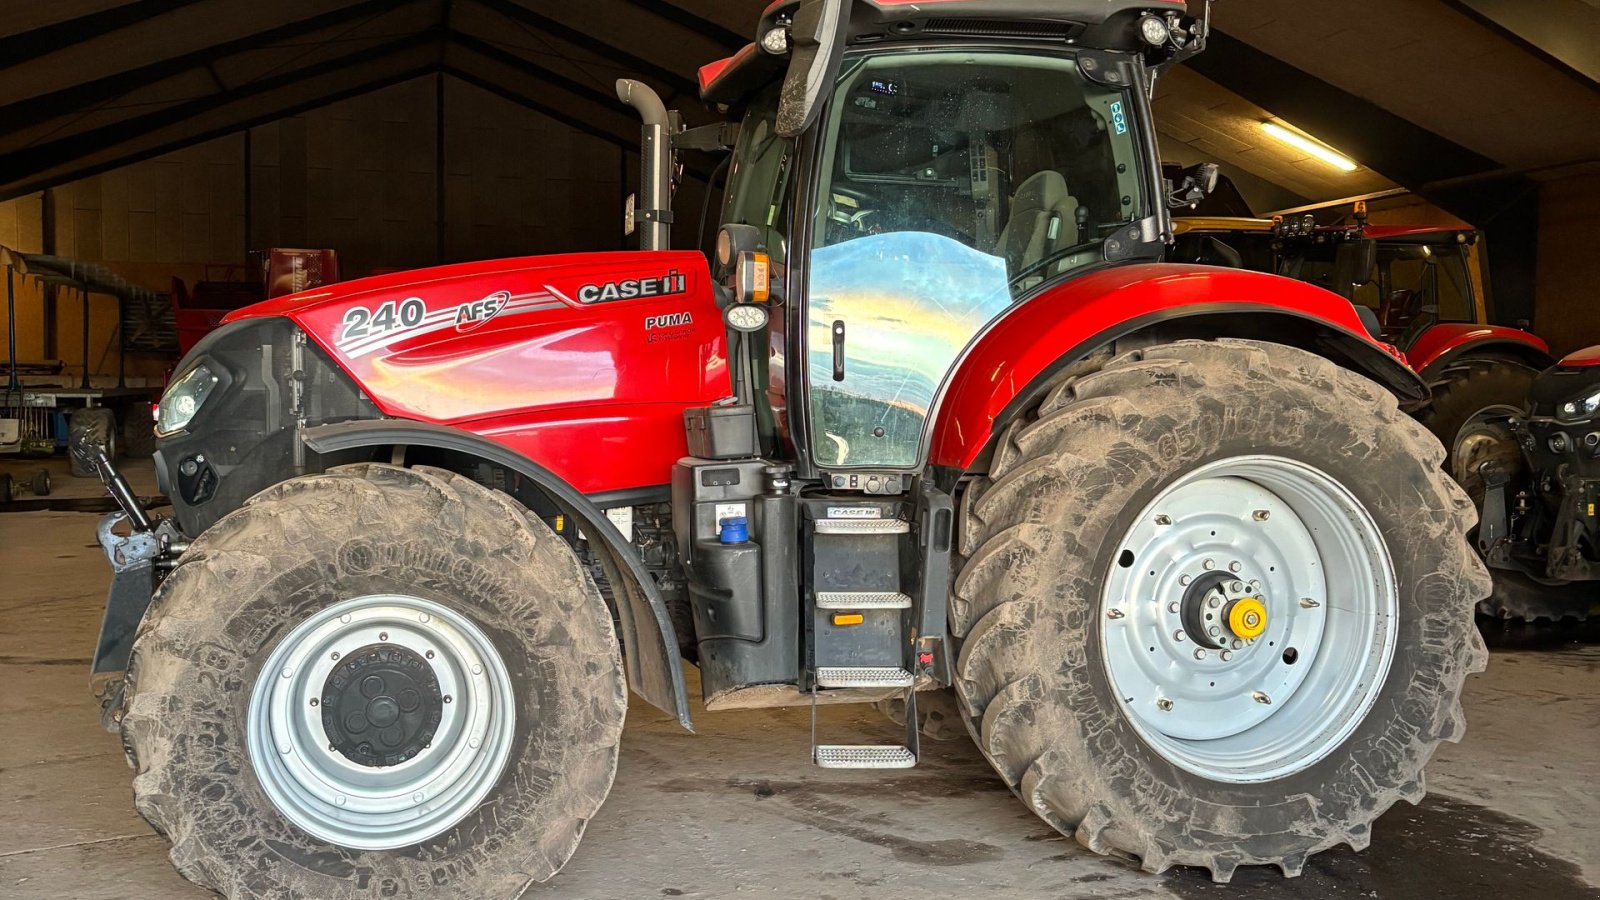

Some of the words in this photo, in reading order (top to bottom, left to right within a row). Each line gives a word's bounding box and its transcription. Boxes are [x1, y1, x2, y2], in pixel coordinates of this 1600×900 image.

[578, 279, 659, 303] CASE
[342, 298, 426, 341] 240
[456, 299, 499, 325] AFS
[646, 312, 692, 329] PUMA
[832, 508, 864, 516] CASE
